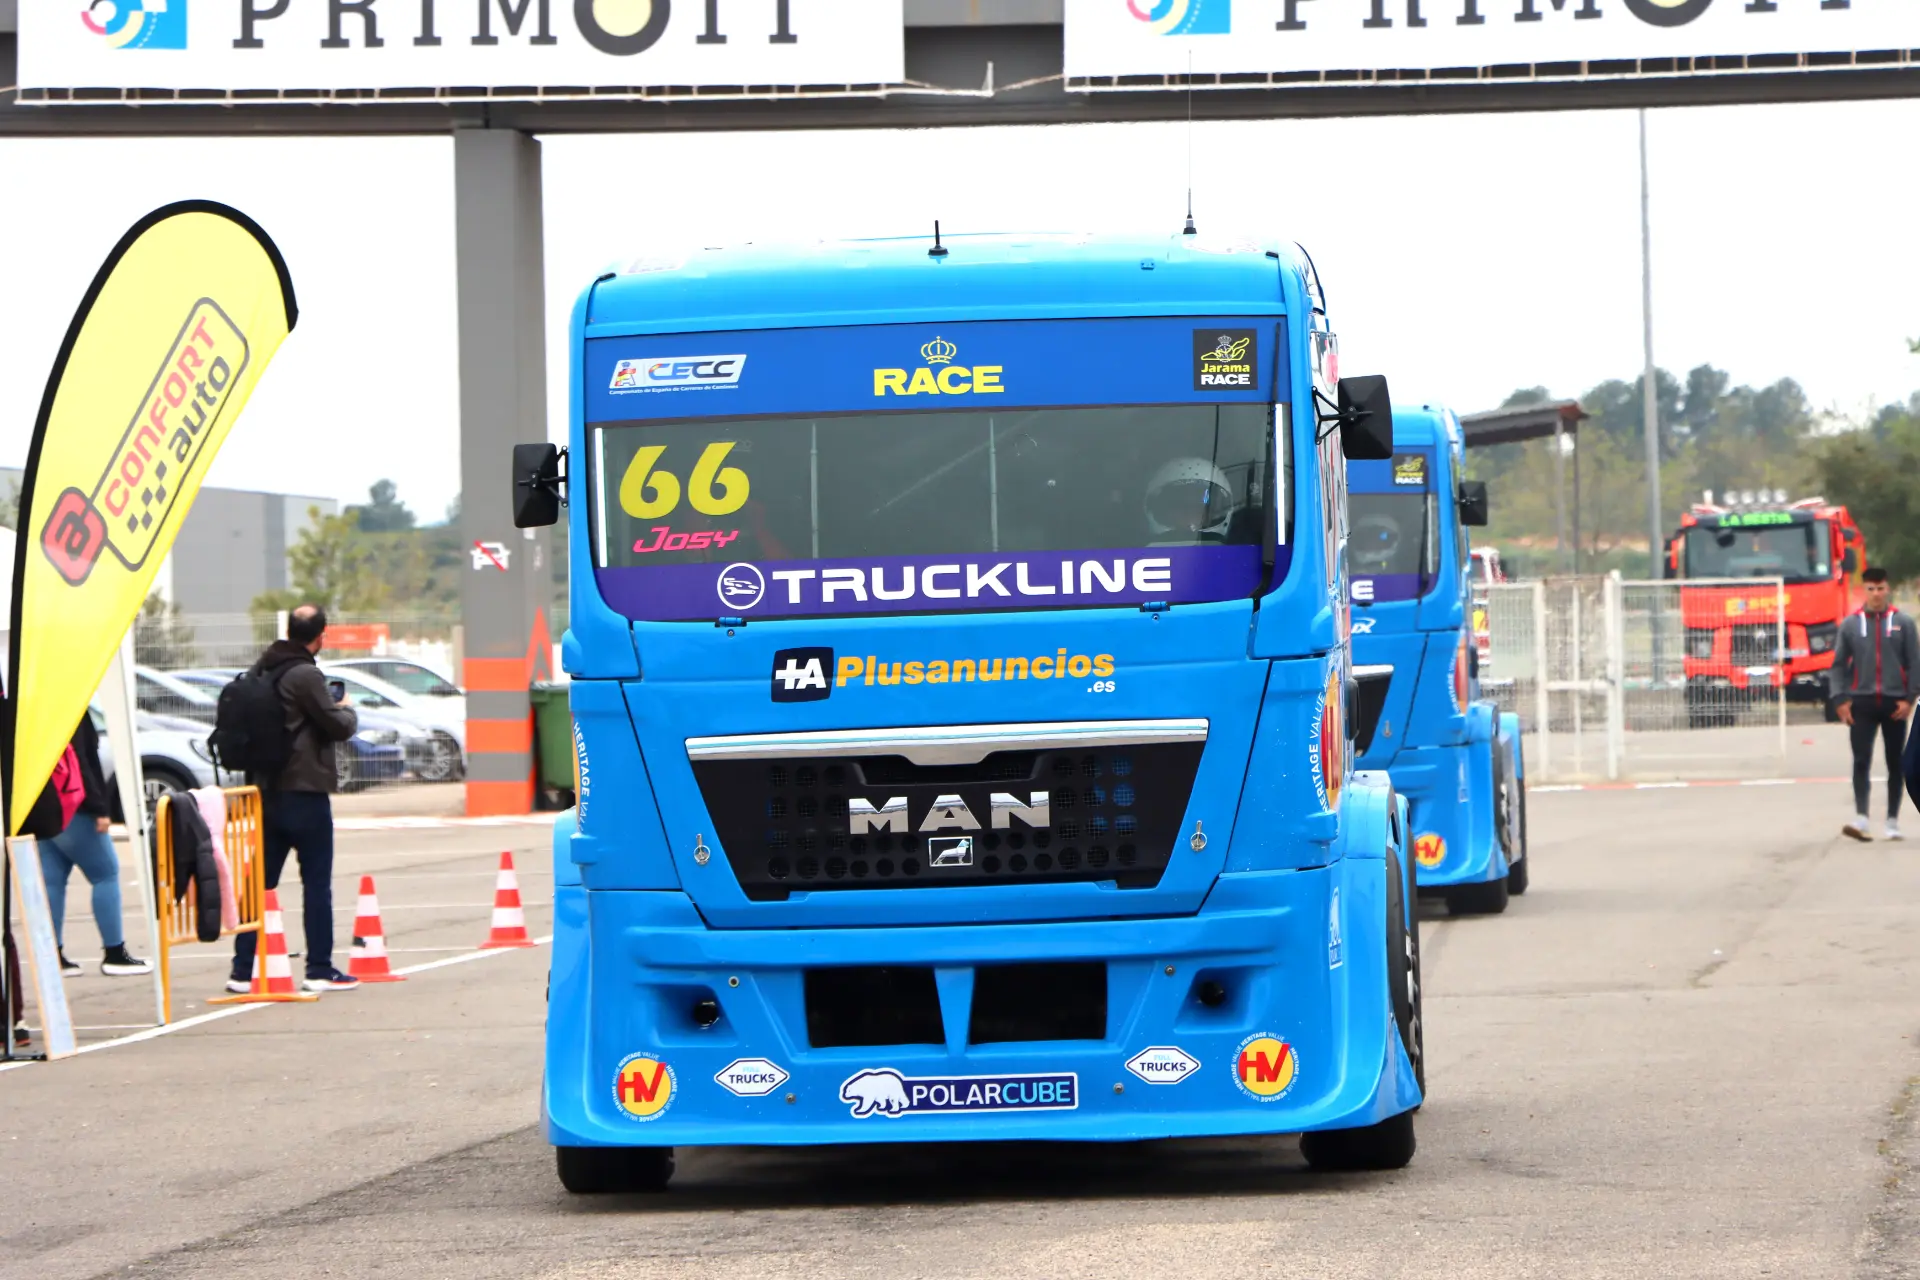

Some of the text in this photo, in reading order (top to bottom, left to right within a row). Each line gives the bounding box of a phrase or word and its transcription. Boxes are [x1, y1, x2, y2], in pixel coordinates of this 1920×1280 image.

[648, 360, 736, 381] CECC
[874, 365, 1005, 396] RACE
[1201, 363, 1251, 373] Jarama
[1201, 373, 1251, 385] RACE
[168, 355, 231, 463] auto
[619, 441, 750, 519] 66
[772, 557, 1172, 604] TRUCKLINE
[836, 648, 1115, 687] Plusanuncios
[1087, 680, 1116, 693] .es
[1309, 692, 1326, 739] VALUE
[573, 721, 590, 797] HERITAGE
[848, 791, 1050, 834] MAN
[728, 1072, 776, 1085] TRUCKS
[1139, 1062, 1187, 1072] TRUCKS
[1238, 1043, 1291, 1083] HV
[617, 1062, 667, 1104] HV
